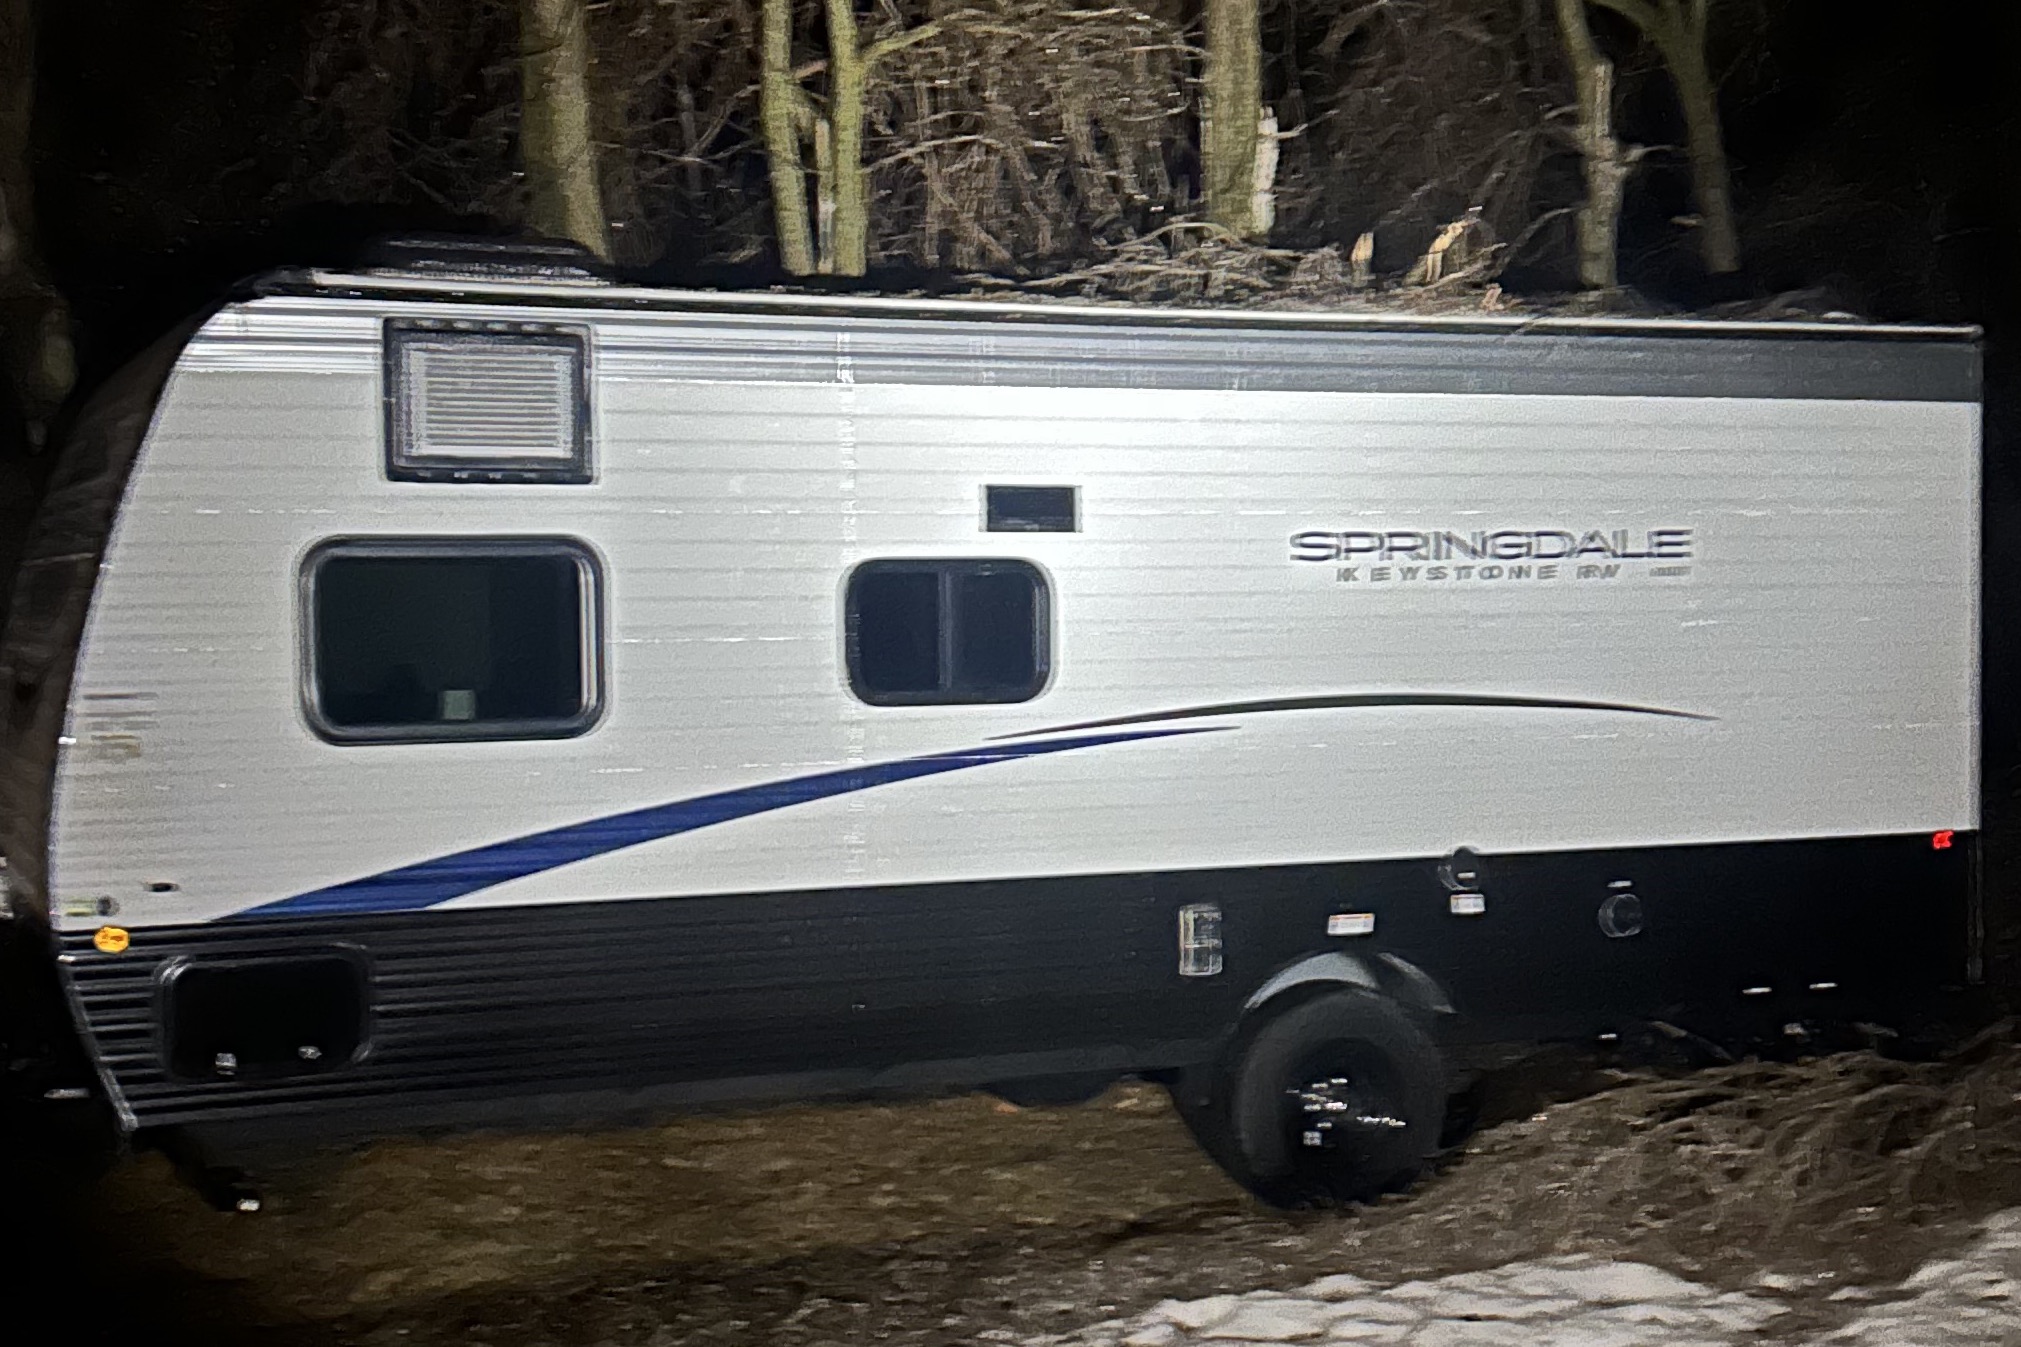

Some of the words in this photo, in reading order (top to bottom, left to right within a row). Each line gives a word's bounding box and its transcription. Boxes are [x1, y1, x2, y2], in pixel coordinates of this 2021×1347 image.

[1290, 529, 1693, 561] SPRINGDALE
[1337, 564, 1558, 582] KEYSTONE
[1576, 564, 1621, 581] RV
